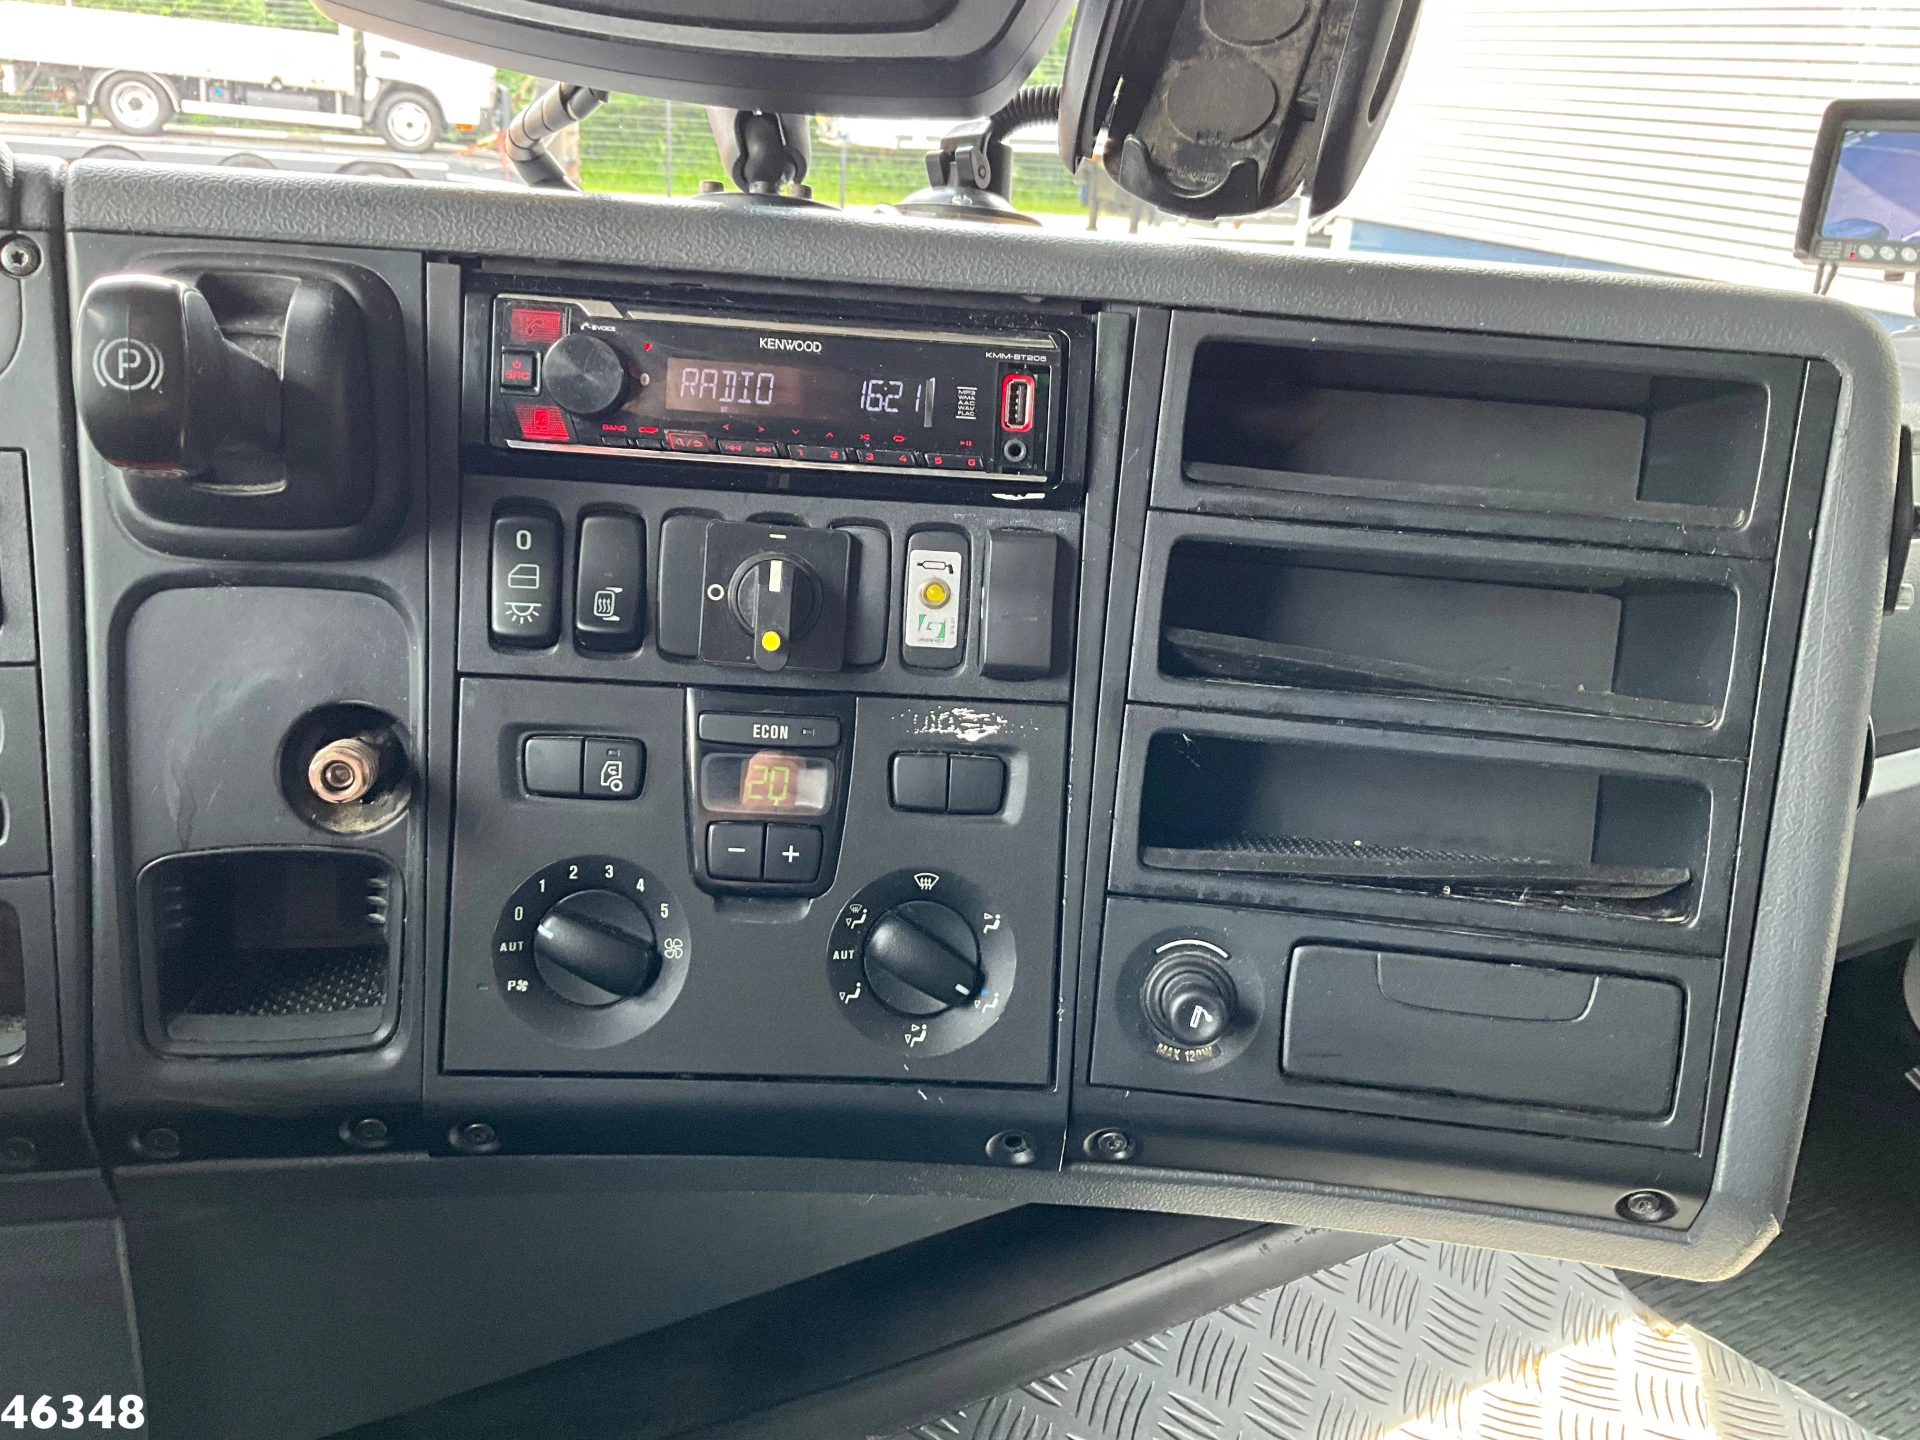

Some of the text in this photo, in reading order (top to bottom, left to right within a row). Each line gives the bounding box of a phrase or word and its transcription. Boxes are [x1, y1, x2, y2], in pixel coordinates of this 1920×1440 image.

[759, 337, 822, 353] KENWOOD
[117, 348, 141, 379] P
[985, 351, 1047, 362] KMM-BT205
[505, 369, 530, 380] SRC
[680, 367, 775, 405] RADIO
[602, 424, 627, 432] BAND
[830, 451, 838, 459] 2
[865, 452, 874, 461] 3
[898, 455, 907, 463] 4
[934, 456, 943, 465] 5
[753, 724, 789, 740] ECON
[747, 765, 790, 801] 20
[569, 865, 579, 880] 2
[604, 865, 614, 879] 3
[538, 879, 546, 893] 1
[636, 878, 645, 892] 4
[660, 903, 669, 918] 5
[500, 941, 525, 952] AUT
[833, 949, 855, 960] AUT
[1156, 1042, 1213, 1062] MAX 120W
